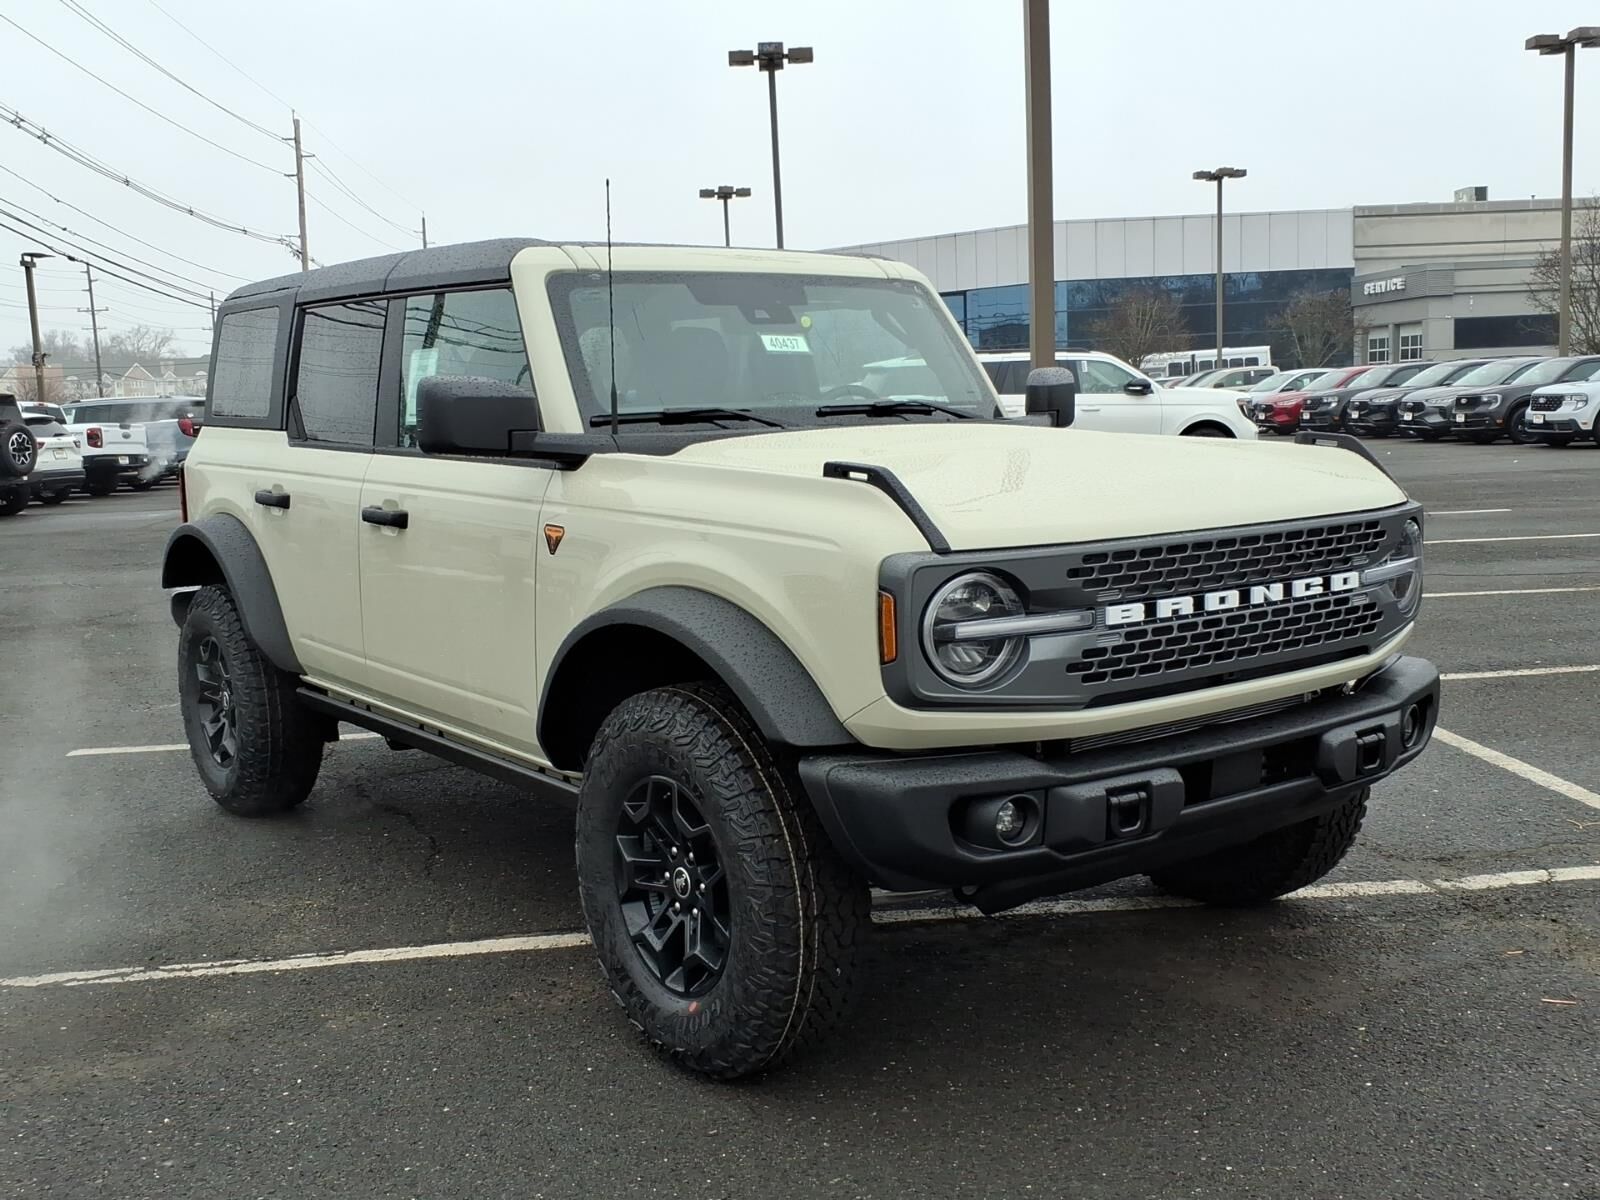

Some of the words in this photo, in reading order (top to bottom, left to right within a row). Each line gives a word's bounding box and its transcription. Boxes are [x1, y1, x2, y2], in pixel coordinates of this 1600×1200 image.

[1363, 277, 1406, 295] SERVICE
[769, 337, 800, 350] 40437
[1106, 571, 1360, 626] BRONCO
